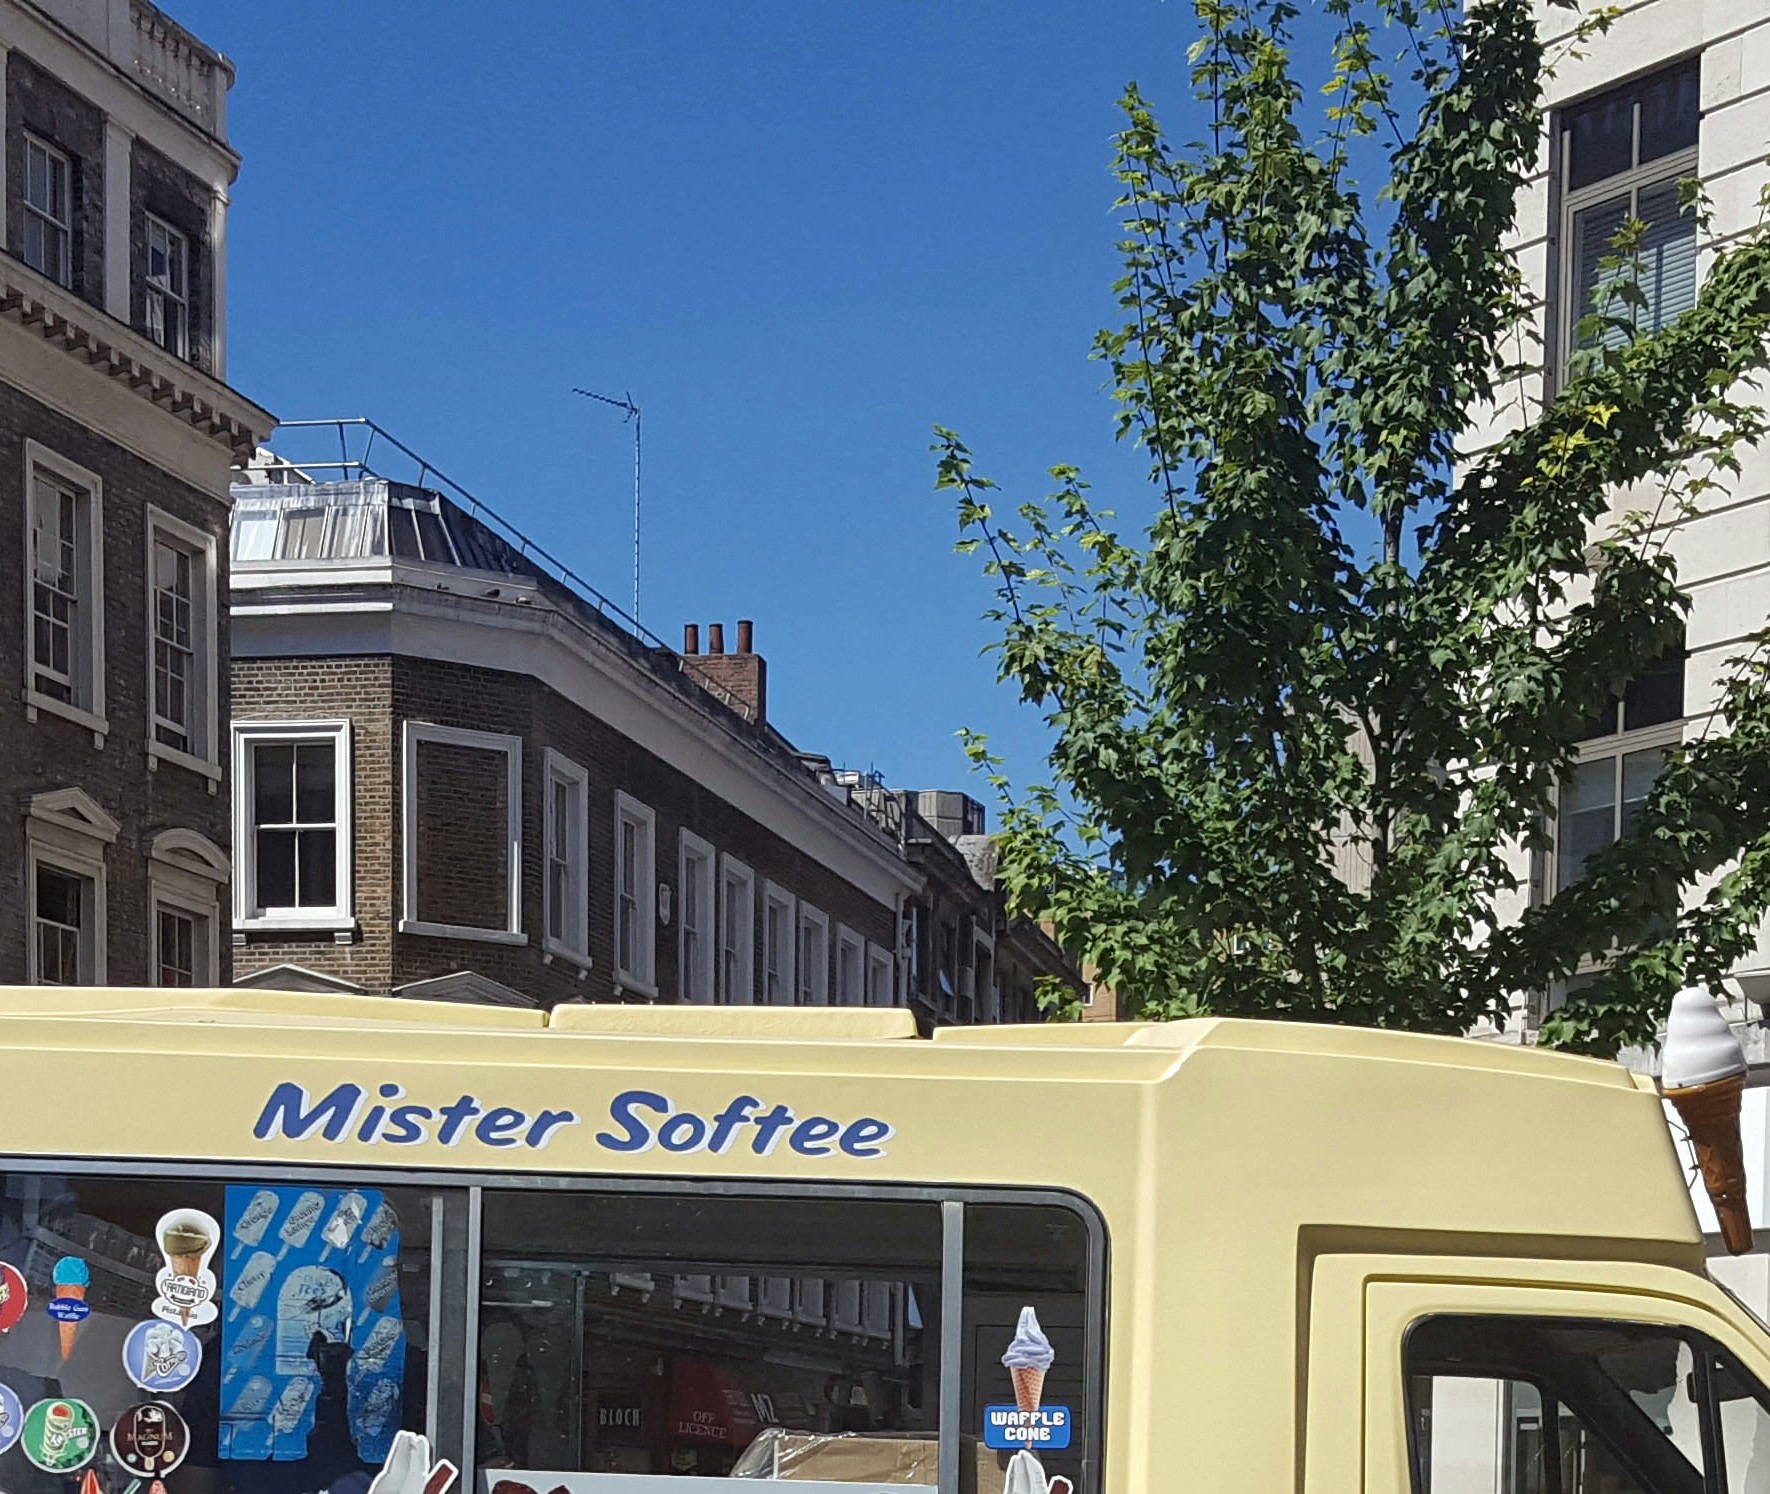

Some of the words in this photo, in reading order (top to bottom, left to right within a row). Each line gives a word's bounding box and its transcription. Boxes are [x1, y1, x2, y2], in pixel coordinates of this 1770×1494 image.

[253, 1082, 580, 1149] Mister
[596, 1091, 897, 1158] Softee
[49, 1302, 72, 1312] Bubble
[692, 1410, 717, 1424] OFF
[990, 1411, 1066, 1427] WAFFLE
[679, 1424, 728, 1440] LICENCE
[1004, 1427, 1052, 1442] CONE
